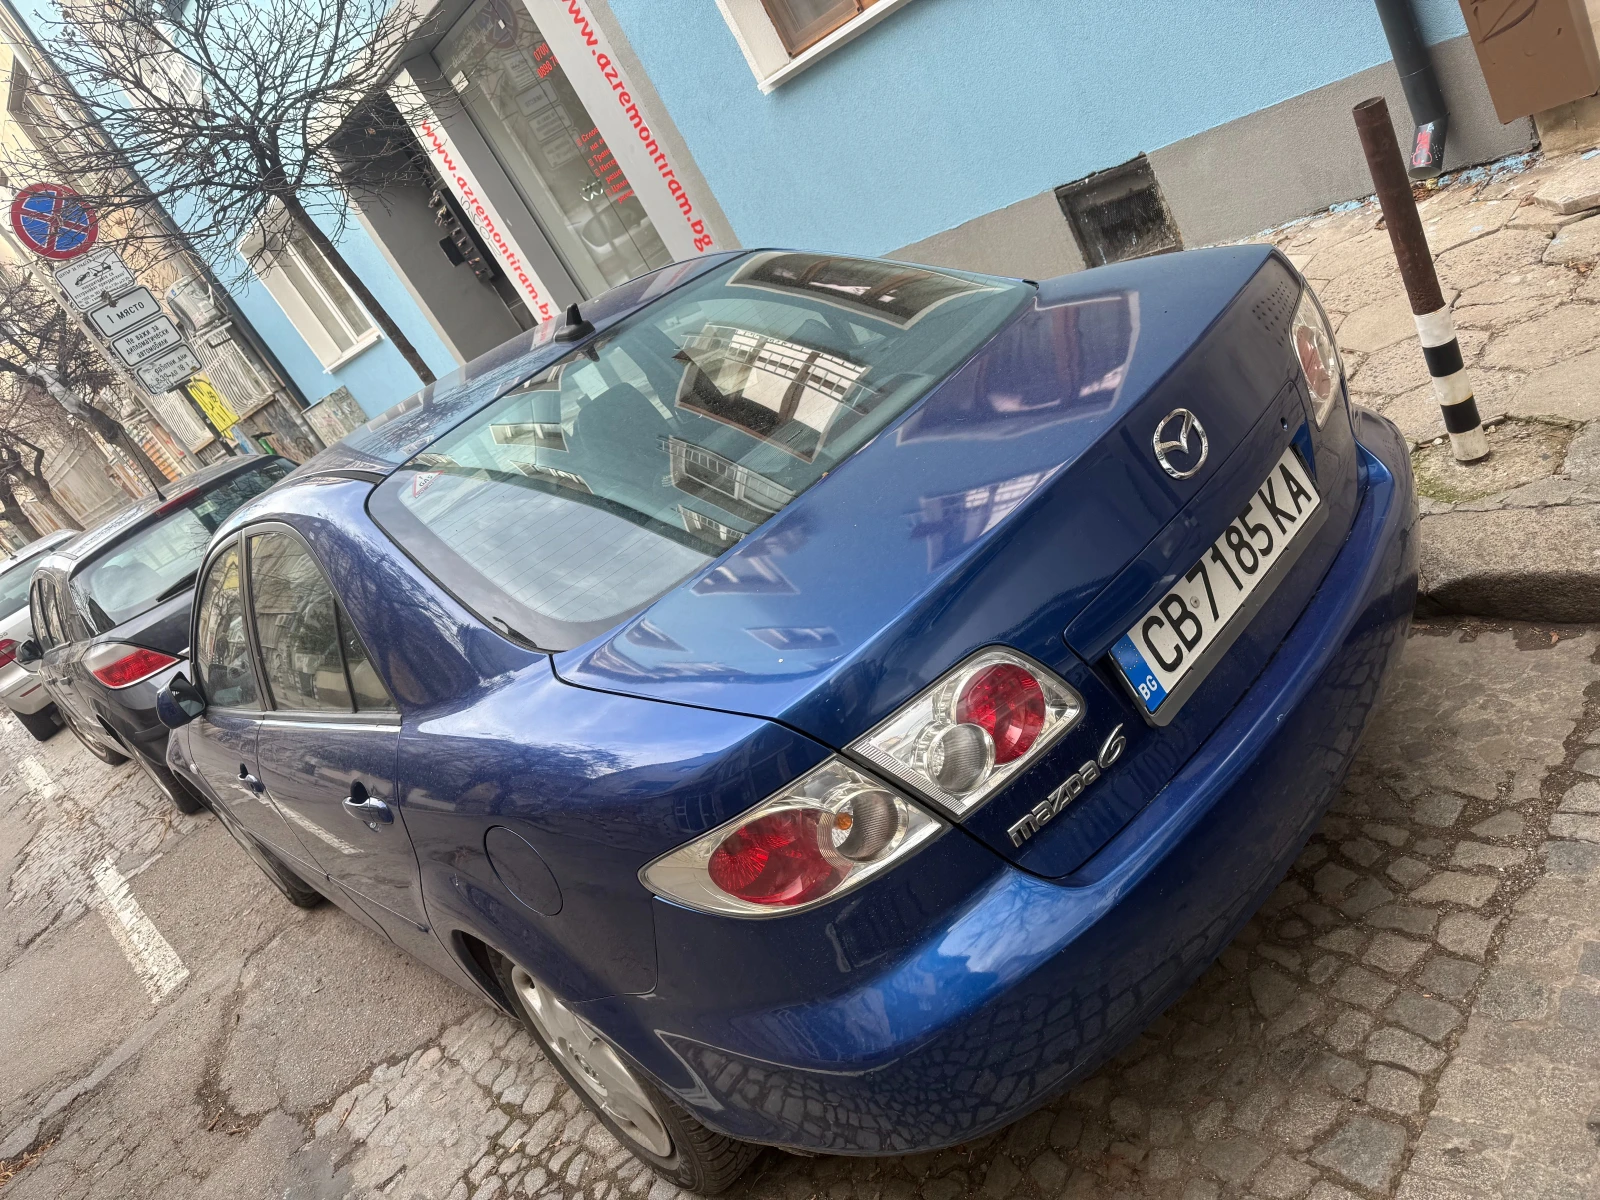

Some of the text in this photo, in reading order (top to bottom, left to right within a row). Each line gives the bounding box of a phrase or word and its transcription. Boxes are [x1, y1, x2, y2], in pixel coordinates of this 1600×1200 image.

[533, 42, 549, 61] 0700
[562, 0, 713, 252] ww.azremontiram.bg
[106, 301, 145, 324] 1 МЯСТО
[125, 337, 134, 346] Не
[135, 329, 150, 341] важи
[126, 328, 170, 356] дипломатически
[136, 338, 169, 359] автомобили
[154, 358, 177, 375] работни
[1141, 462, 1312, 673] CB 7185 KA
[1138, 674, 1158, 701] BG
